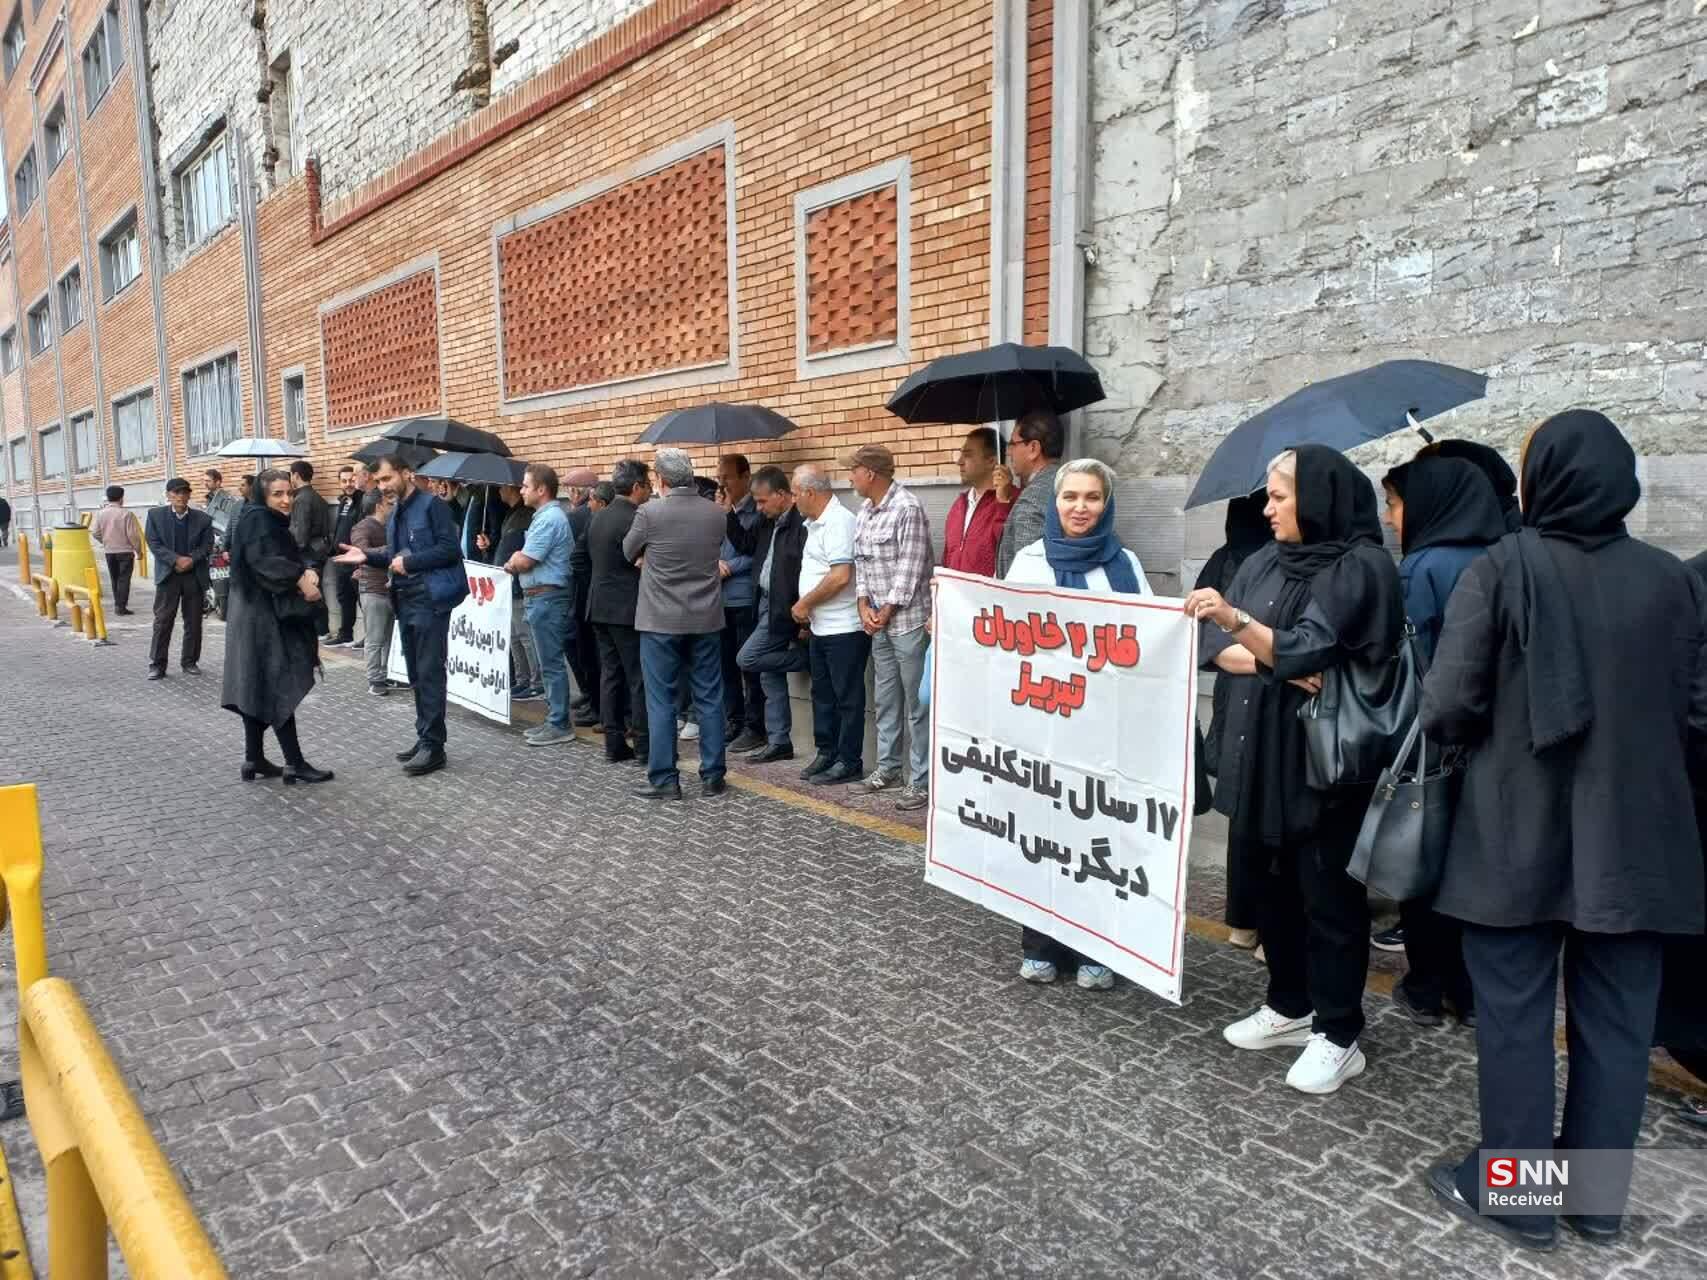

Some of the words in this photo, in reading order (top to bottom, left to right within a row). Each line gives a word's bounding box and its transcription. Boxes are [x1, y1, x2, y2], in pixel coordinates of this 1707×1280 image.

[972, 604, 1067, 656] خاوران
[1065, 621, 1087, 658] ۲
[1087, 623, 1140, 672] فاز
[1011, 660, 1086, 717] تبریز
[941, 737, 1062, 810] بلاتکلیفی
[957, 797, 1015, 844] است
[1068, 775, 1138, 823] سال
[1144, 797, 1179, 841] ۱۷
[1019, 833, 1071, 876] بس
[1074, 836, 1149, 901] دیگر
